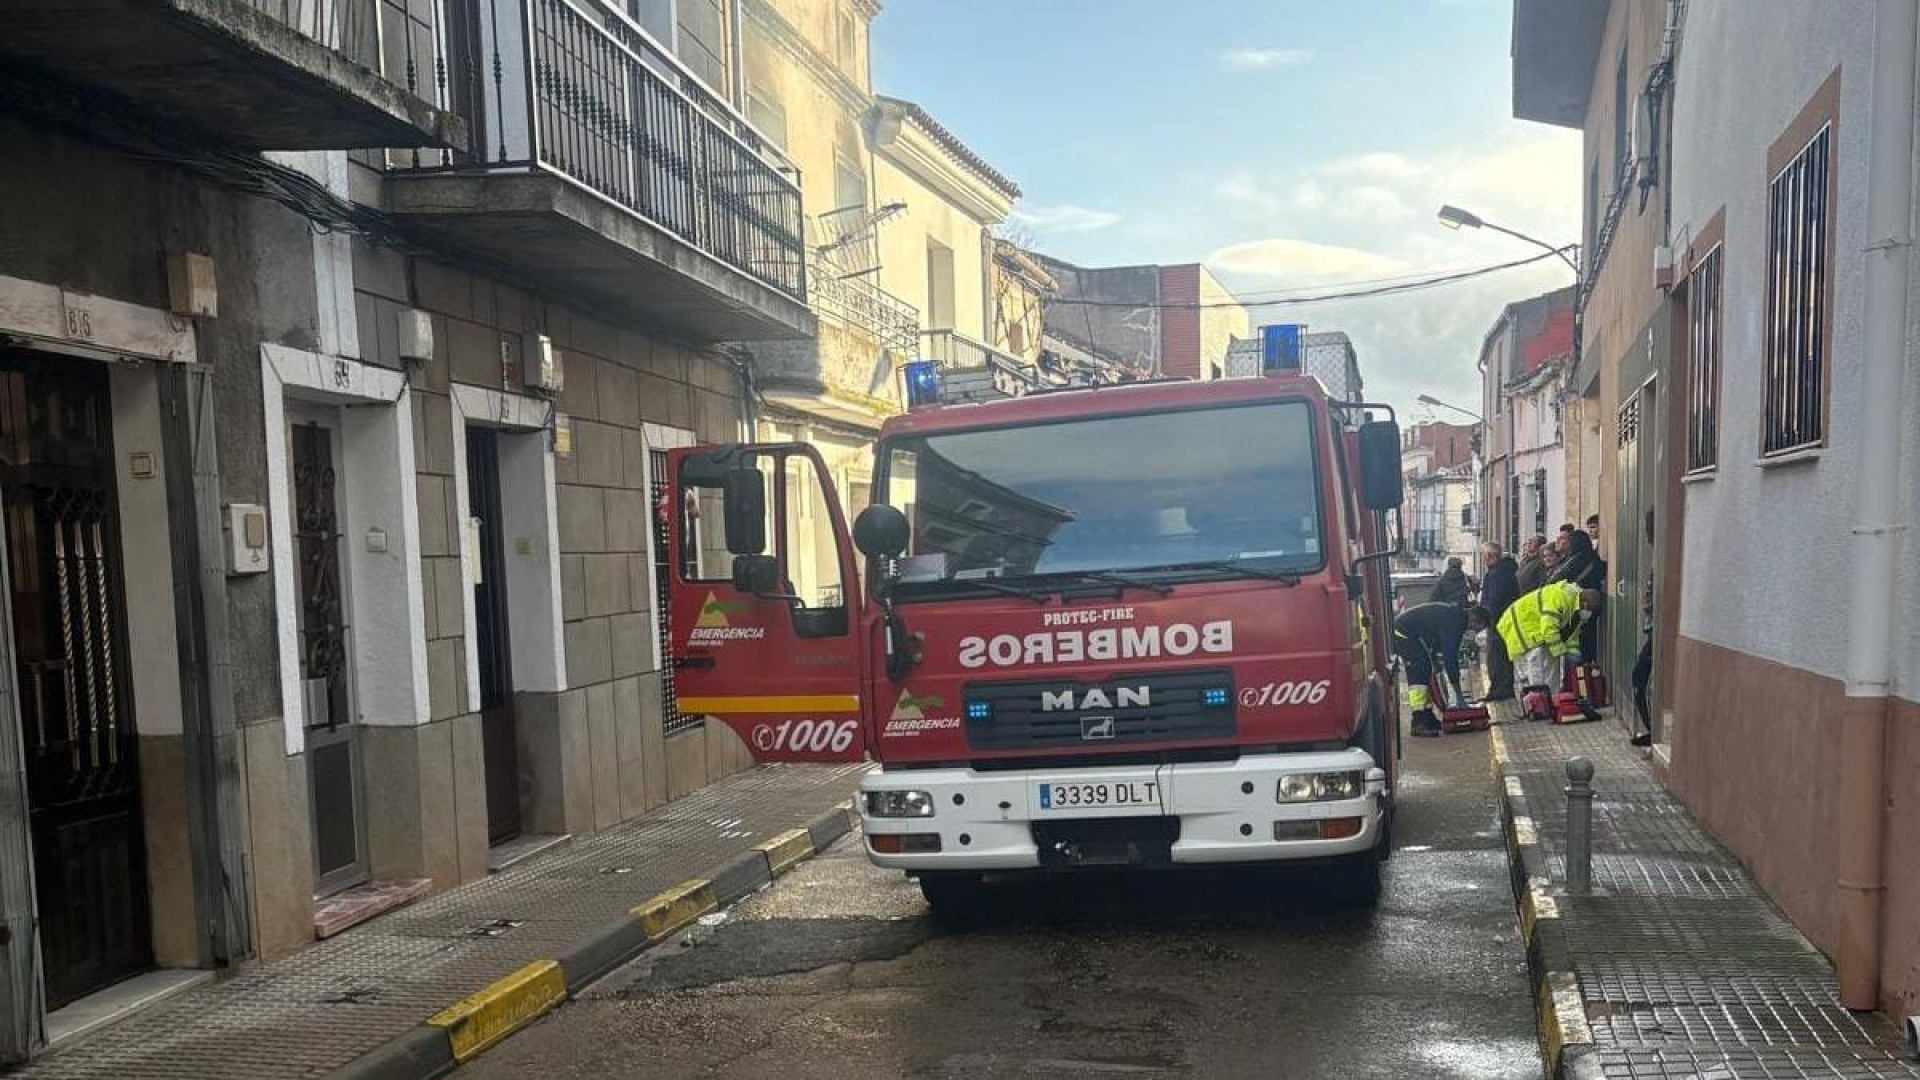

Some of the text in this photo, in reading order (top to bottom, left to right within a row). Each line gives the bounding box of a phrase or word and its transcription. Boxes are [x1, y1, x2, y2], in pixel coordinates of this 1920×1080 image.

[1043, 607, 1135, 627] PROTEC-FIRE
[689, 627, 766, 640] EMERGENCIA
[1042, 685, 1150, 712] MAN
[1256, 680, 1330, 706] 1006
[774, 719, 859, 753] 1006
[884, 717, 961, 732] EMERGENCIA
[1055, 782, 1156, 806] 3339 DLT
